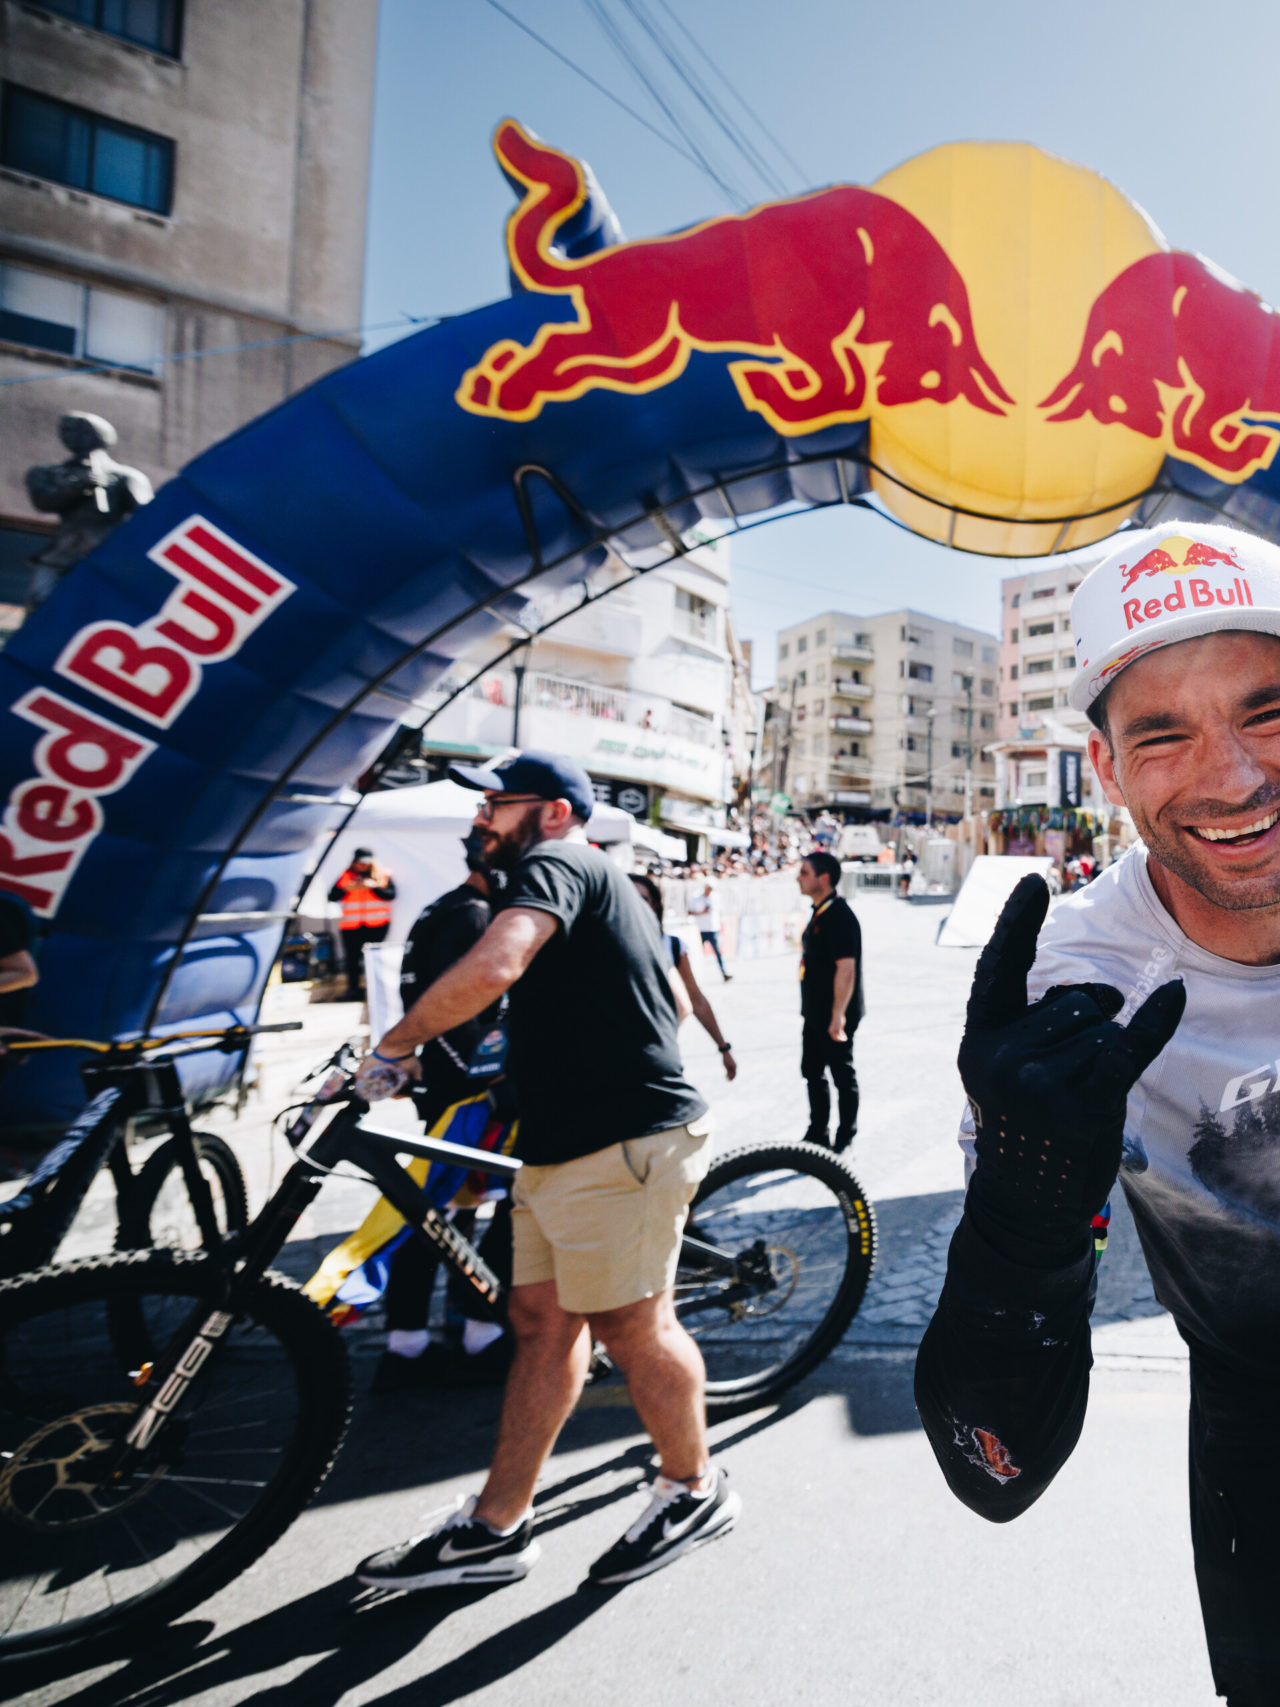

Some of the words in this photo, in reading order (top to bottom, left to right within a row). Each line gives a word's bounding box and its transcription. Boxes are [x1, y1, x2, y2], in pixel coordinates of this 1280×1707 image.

[57, 517, 294, 727] Bull
[1122, 580, 1186, 630] Red
[1189, 578, 1254, 607] Bull
